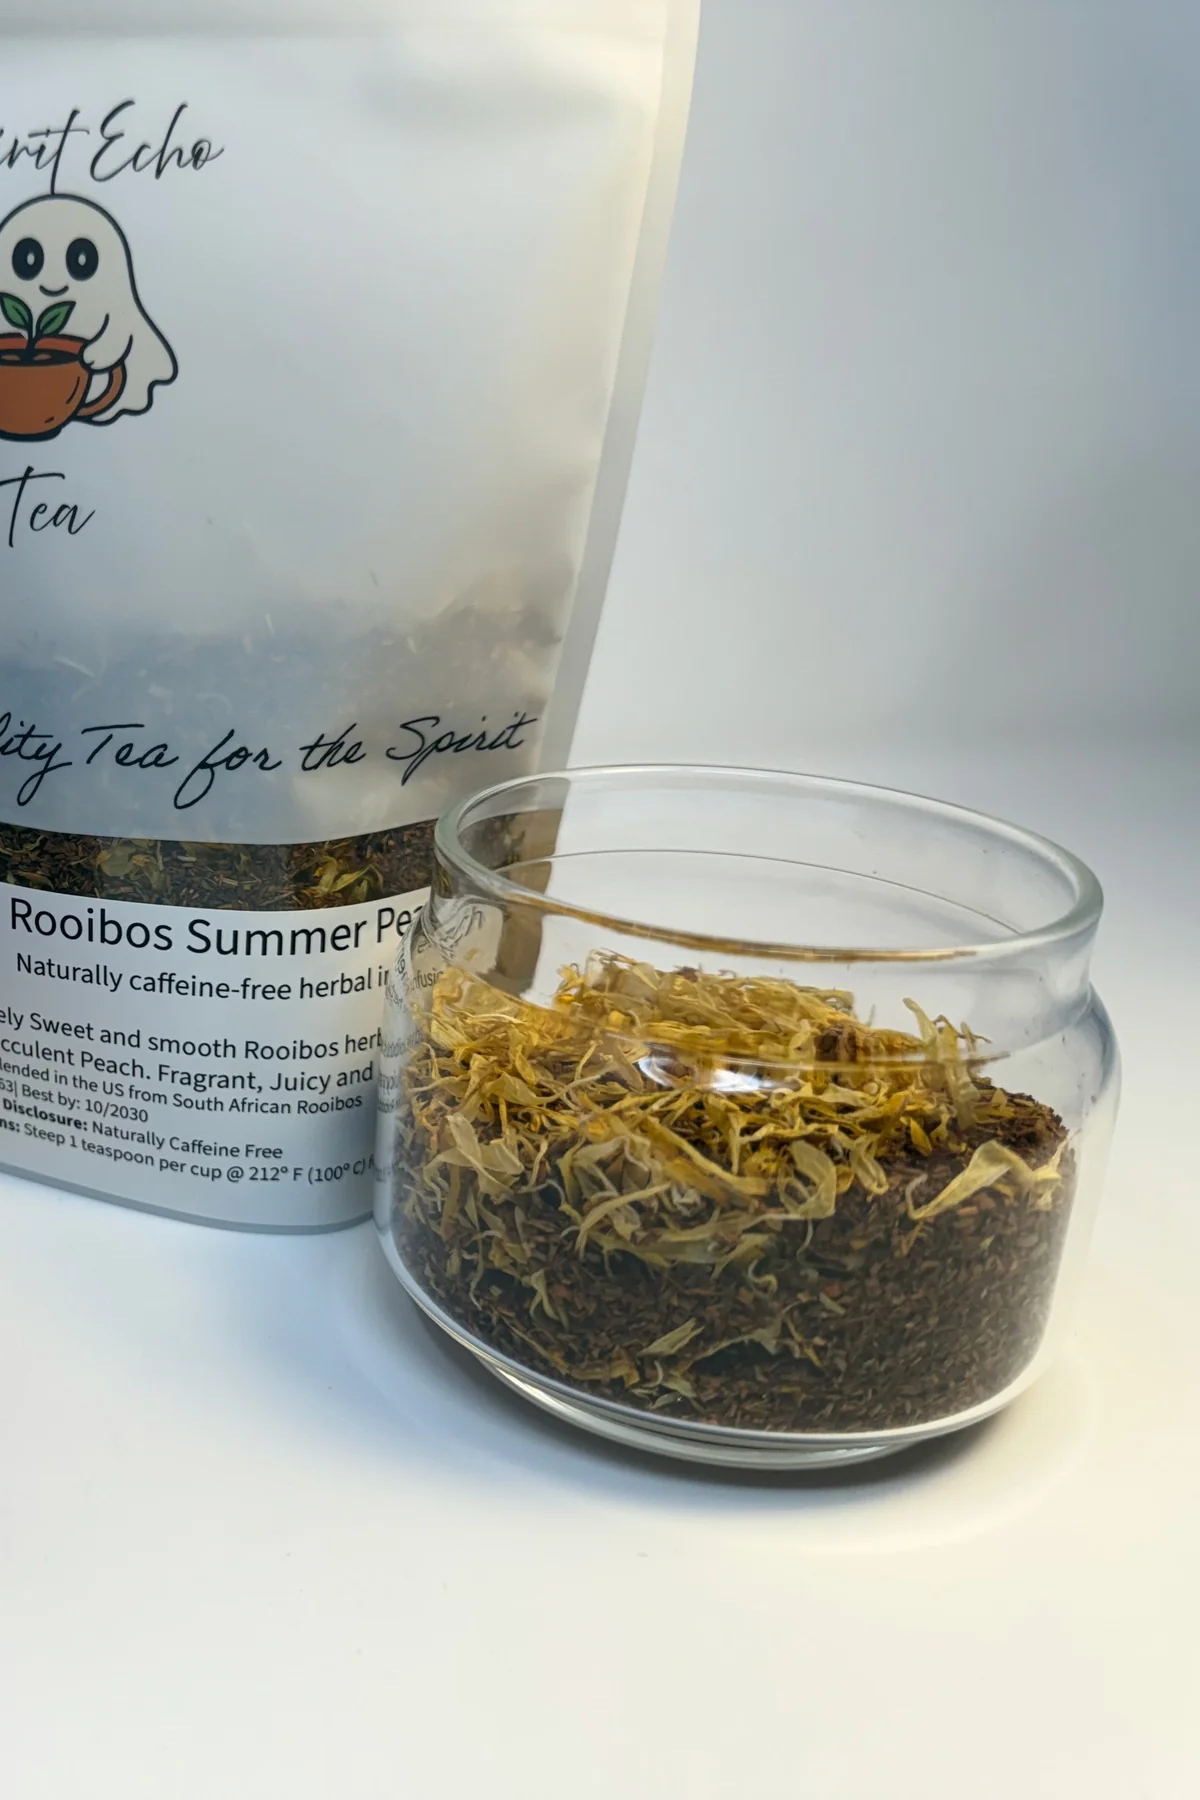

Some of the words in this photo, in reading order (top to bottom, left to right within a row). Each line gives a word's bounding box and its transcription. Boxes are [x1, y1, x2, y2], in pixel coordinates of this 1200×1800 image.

[89, 99, 225, 183] Echo
[80, 723, 179, 768] Tea
[172, 728, 283, 809] for
[300, 723, 367, 771] the
[386, 711, 538, 786] Spirit
[10, 897, 173, 951] Rooibos
[186, 918, 368, 956] Summer
[376, 905, 424, 944] Pe
[17, 952, 123, 993] Naturally
[129, 972, 292, 1000] caffeine-free
[299, 967, 372, 999] herbal
[30, 1012, 95, 1041] Sweet
[99, 1029, 141, 1048] and
[147, 1036, 237, 1059] smooth
[244, 1040, 339, 1060] Rooibos
[53, 1070, 68, 1085] in
[72, 1075, 99, 1092] the
[102, 1080, 125, 1097] US
[128, 1084, 168, 1105] from
[172, 1093, 224, 1112] South
[228, 1097, 291, 1114] African
[297, 1094, 363, 1115] Rooibos
[80, 1050, 151, 1080] Peach.
[158, 1063, 263, 1093] Fragrant,
[269, 1071, 331, 1095] Juicy
[336, 1060, 374, 1087] and
[2, 1097, 88, 1131] Disclosure:
[92, 1120, 166, 1150] Naturally
[169, 1136, 241, 1158] Caffeine
[245, 1143, 283, 1159] Free
[21, 1083, 54, 1103] Best
[58, 1091, 81, 1111] by:
[85, 1098, 149, 1123] 10/2030
[24, 1122, 66, 1146] Steep
[70, 1135, 78, 1148] 1
[81, 1138, 155, 1166] teaspoon
[159, 1158, 187, 1172] per
[189, 1164, 222, 1182] cup
[226, 1165, 245, 1183] @
[292, 1167, 303, 1181] F
[352, 1158, 366, 1176] C)
